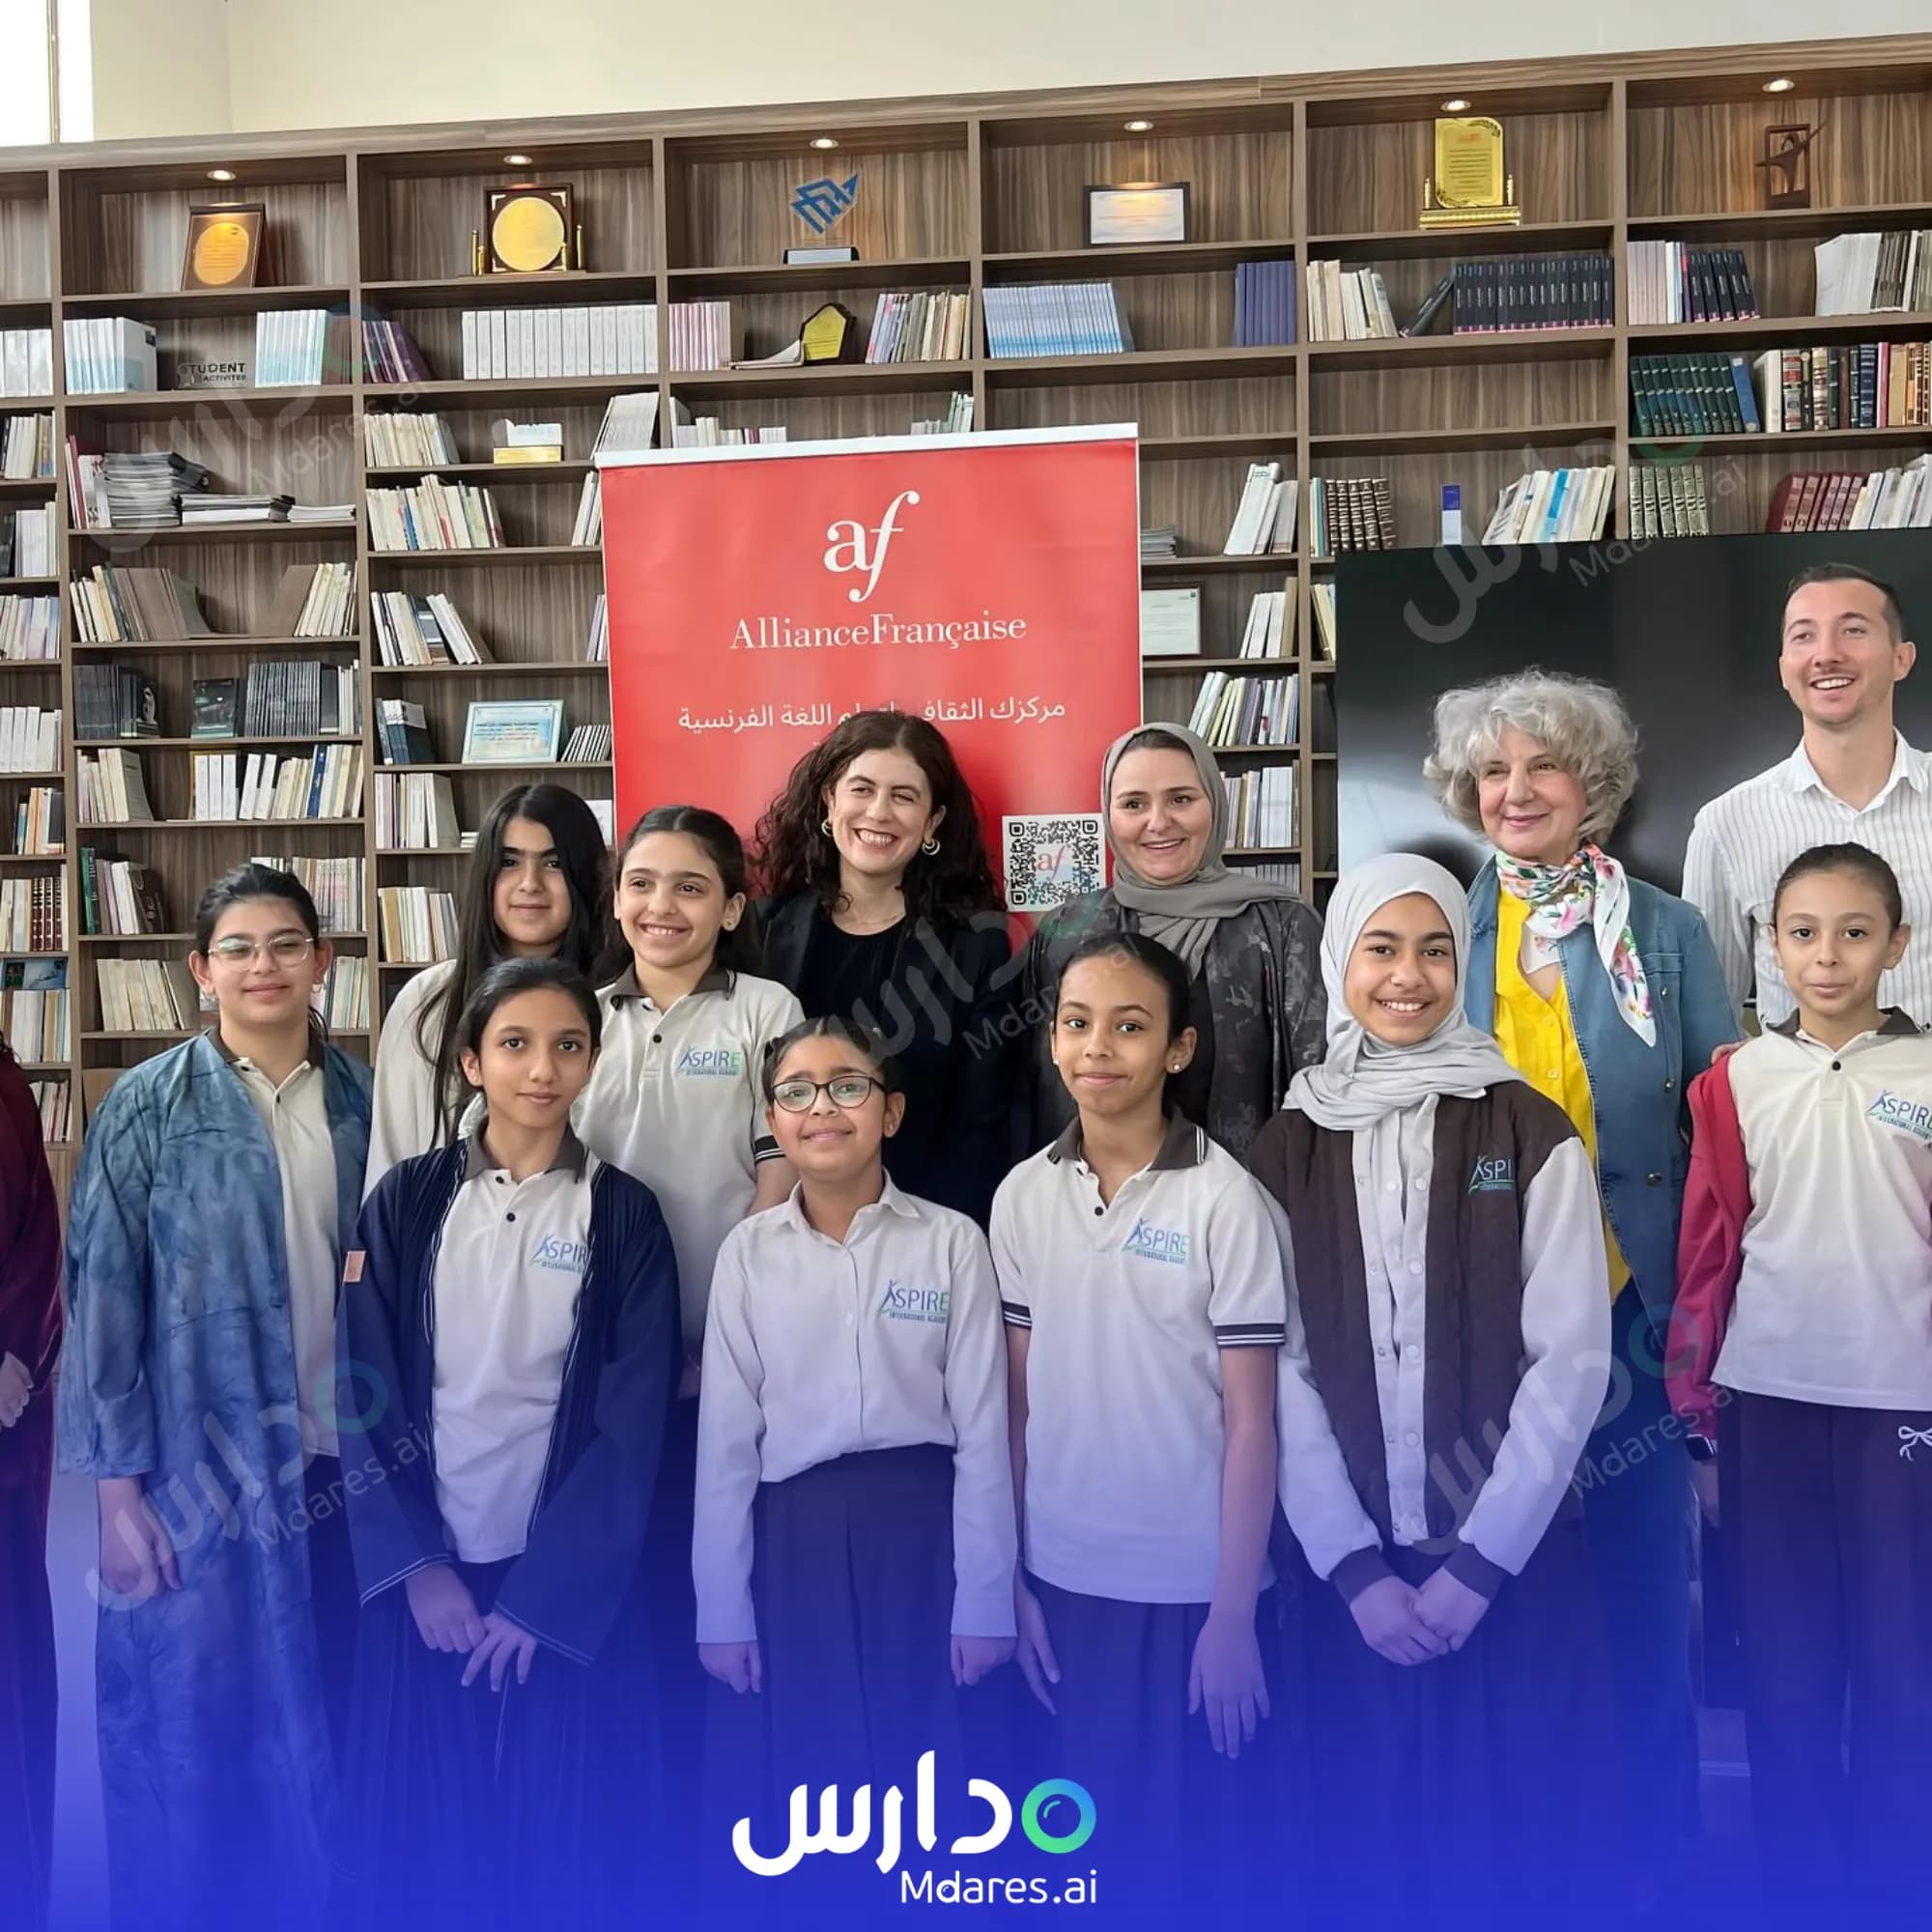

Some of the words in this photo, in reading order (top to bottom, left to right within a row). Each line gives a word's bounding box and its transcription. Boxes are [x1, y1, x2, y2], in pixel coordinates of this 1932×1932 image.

[179, 361, 246, 375] STUDENT
[823, 490, 920, 603] af
[729, 611, 1027, 650] AllianceFrançaise
[678, 705, 773, 735] الفرنسية
[781, 703, 832, 726] اللغة
[923, 698, 983, 723] الثقاف
[989, 696, 1066, 724] مركزك
[679, 1046, 741, 1069] ASPIRE
[1468, 1155, 1513, 1187] ASPI
[532, 1234, 587, 1265] ASPIR
[1122, 1218, 1189, 1253] ASPIRE
[879, 1279, 949, 1312] ASPIRE
